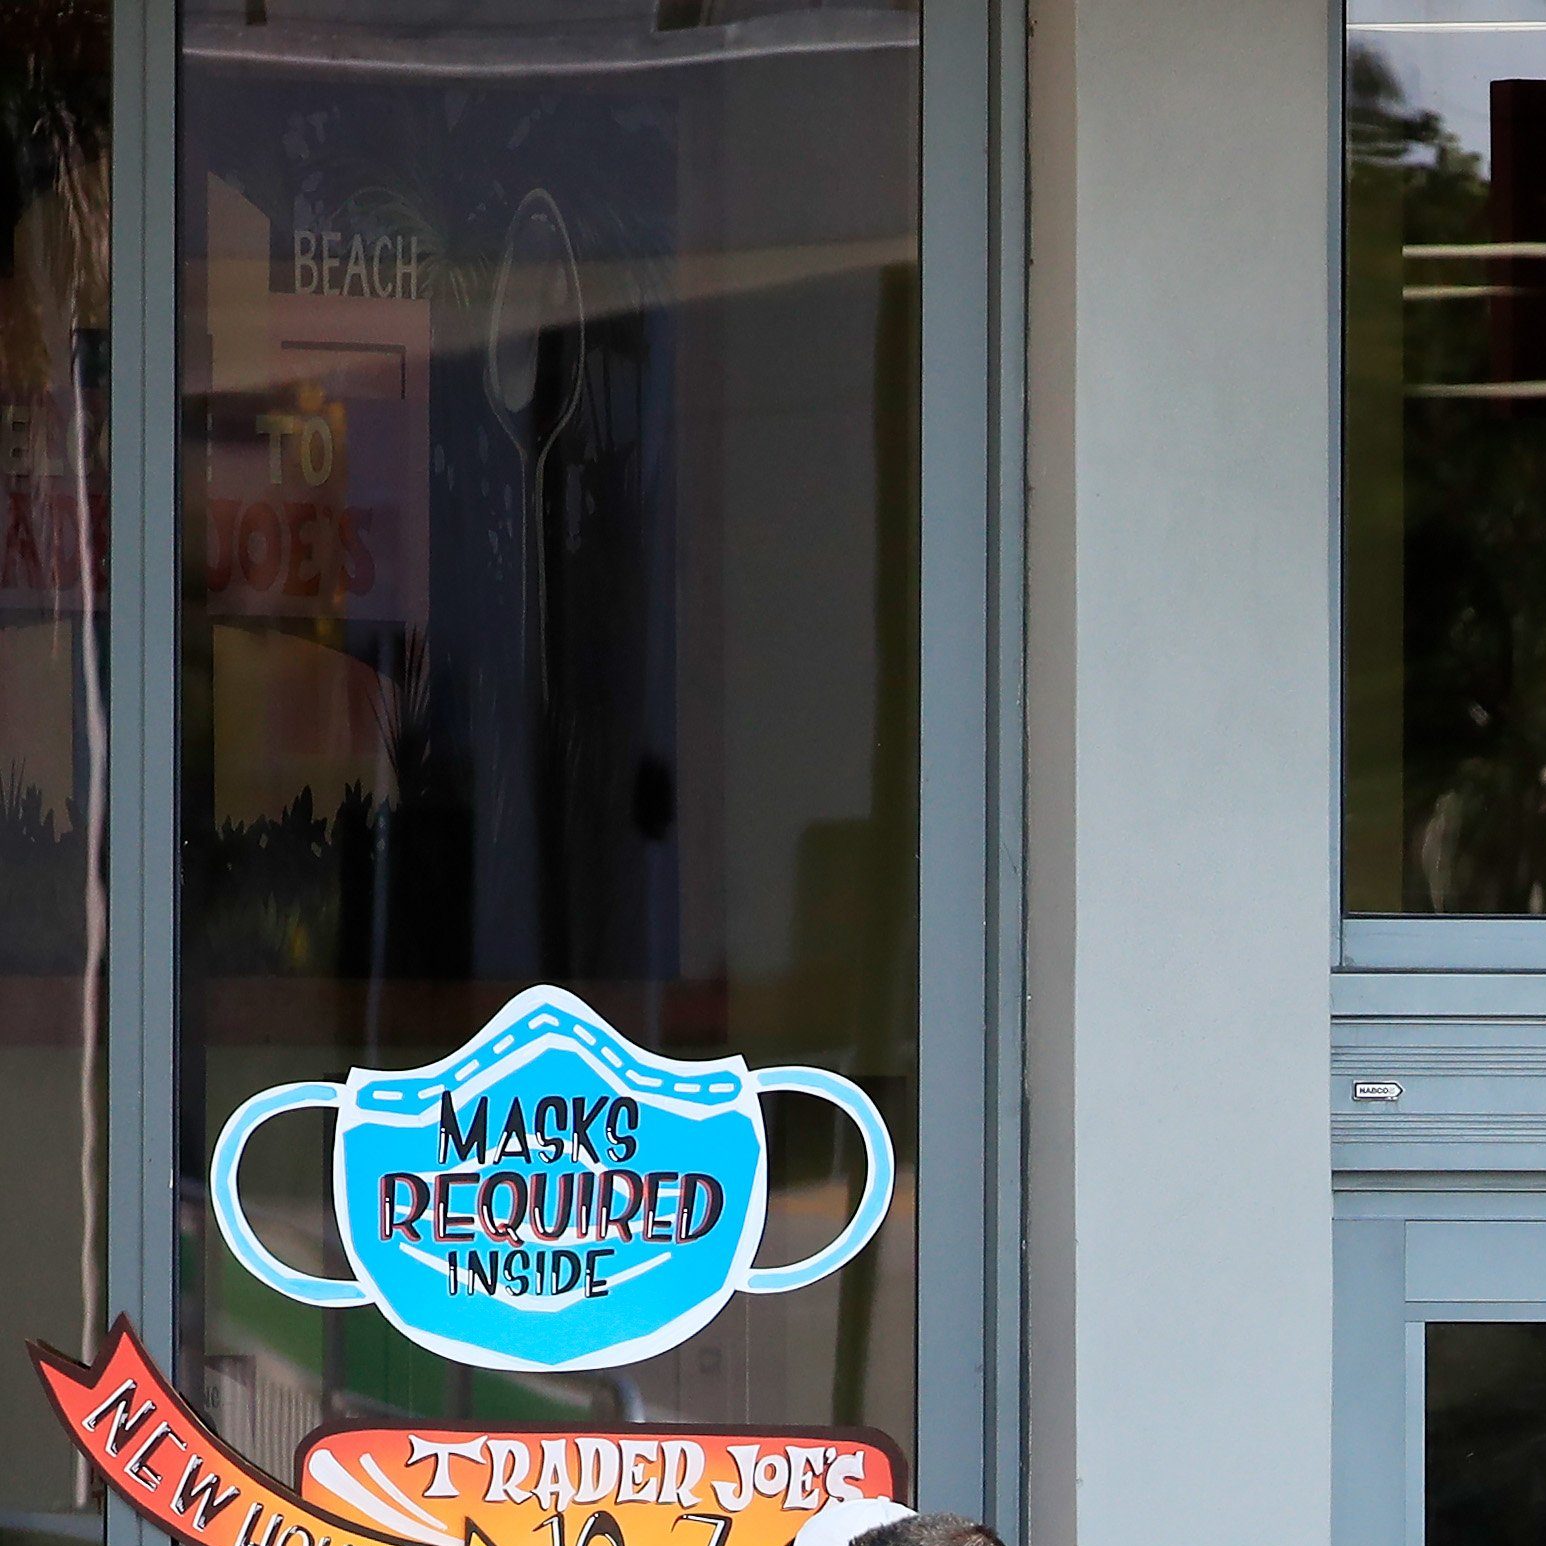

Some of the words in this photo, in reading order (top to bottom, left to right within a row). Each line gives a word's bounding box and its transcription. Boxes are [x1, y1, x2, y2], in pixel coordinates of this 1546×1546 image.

[294, 230, 418, 299] BEACH
[256, 415, 333, 486] TO
[437, 1090, 640, 1165] MASKS
[380, 1170, 725, 1245] REQUIRED
[447, 1248, 611, 1299] INSIDE
[82, 1378, 240, 1532] NEW
[406, 1433, 703, 1511] TRADER
[704, 1443, 868, 1514] JOE'S
